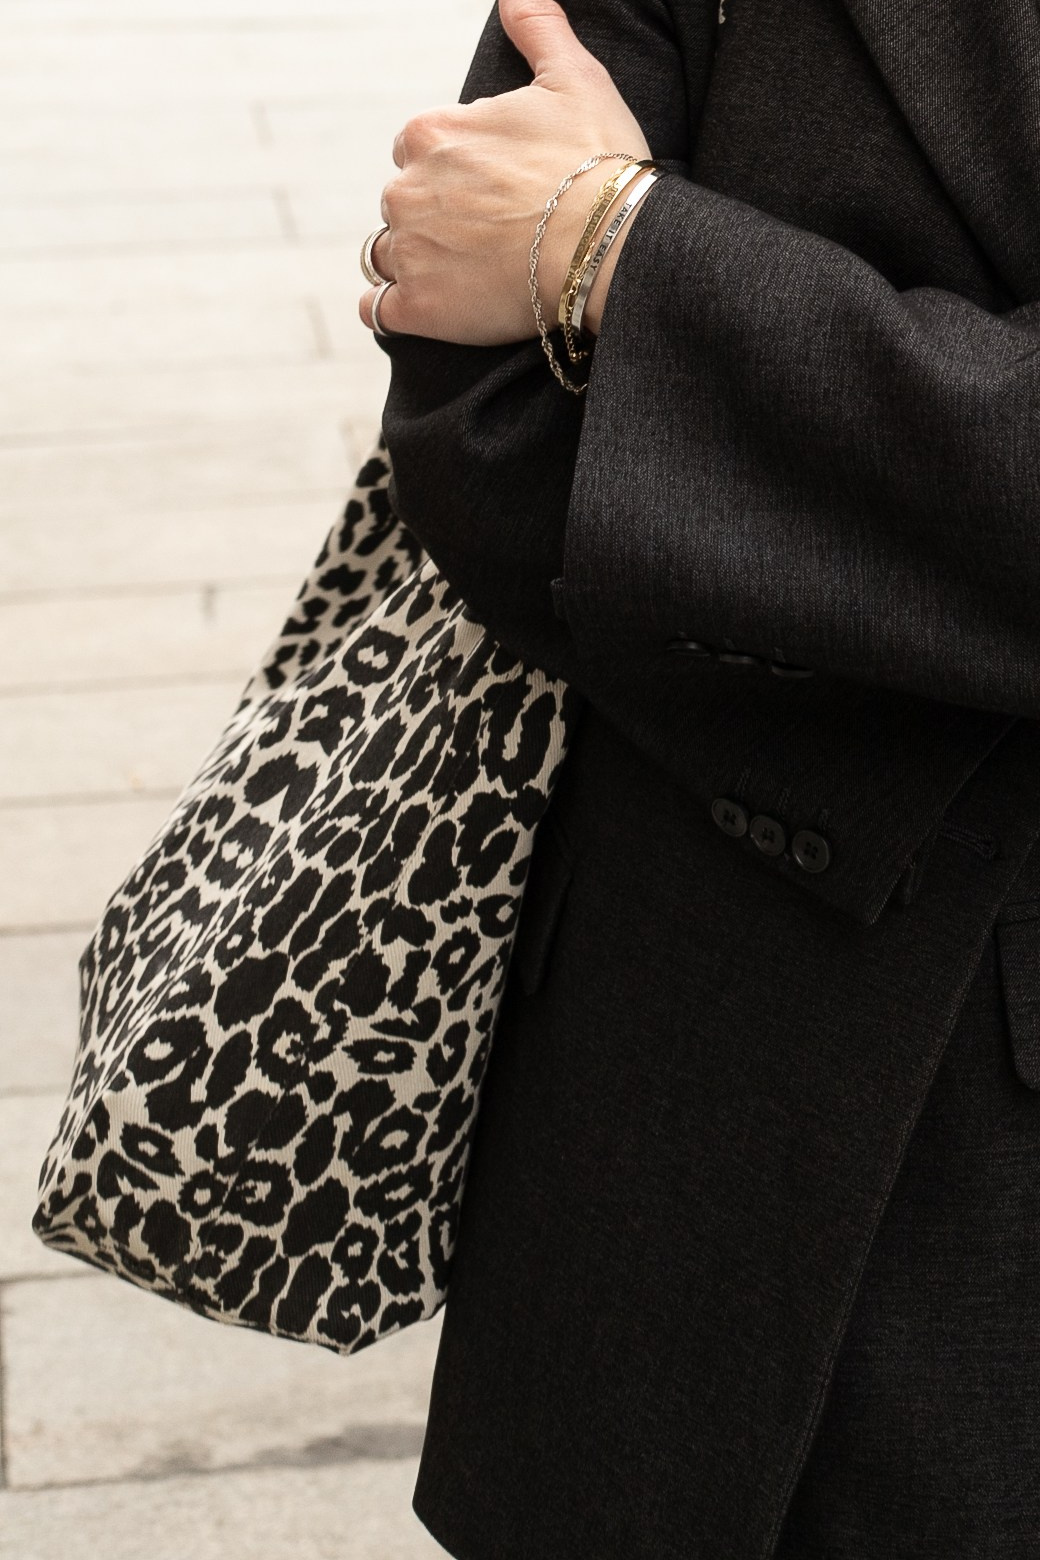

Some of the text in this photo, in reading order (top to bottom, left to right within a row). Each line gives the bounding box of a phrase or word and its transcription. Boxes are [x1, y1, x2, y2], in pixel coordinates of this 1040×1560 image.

[590, 203, 632, 271] TAKE IT EASY
